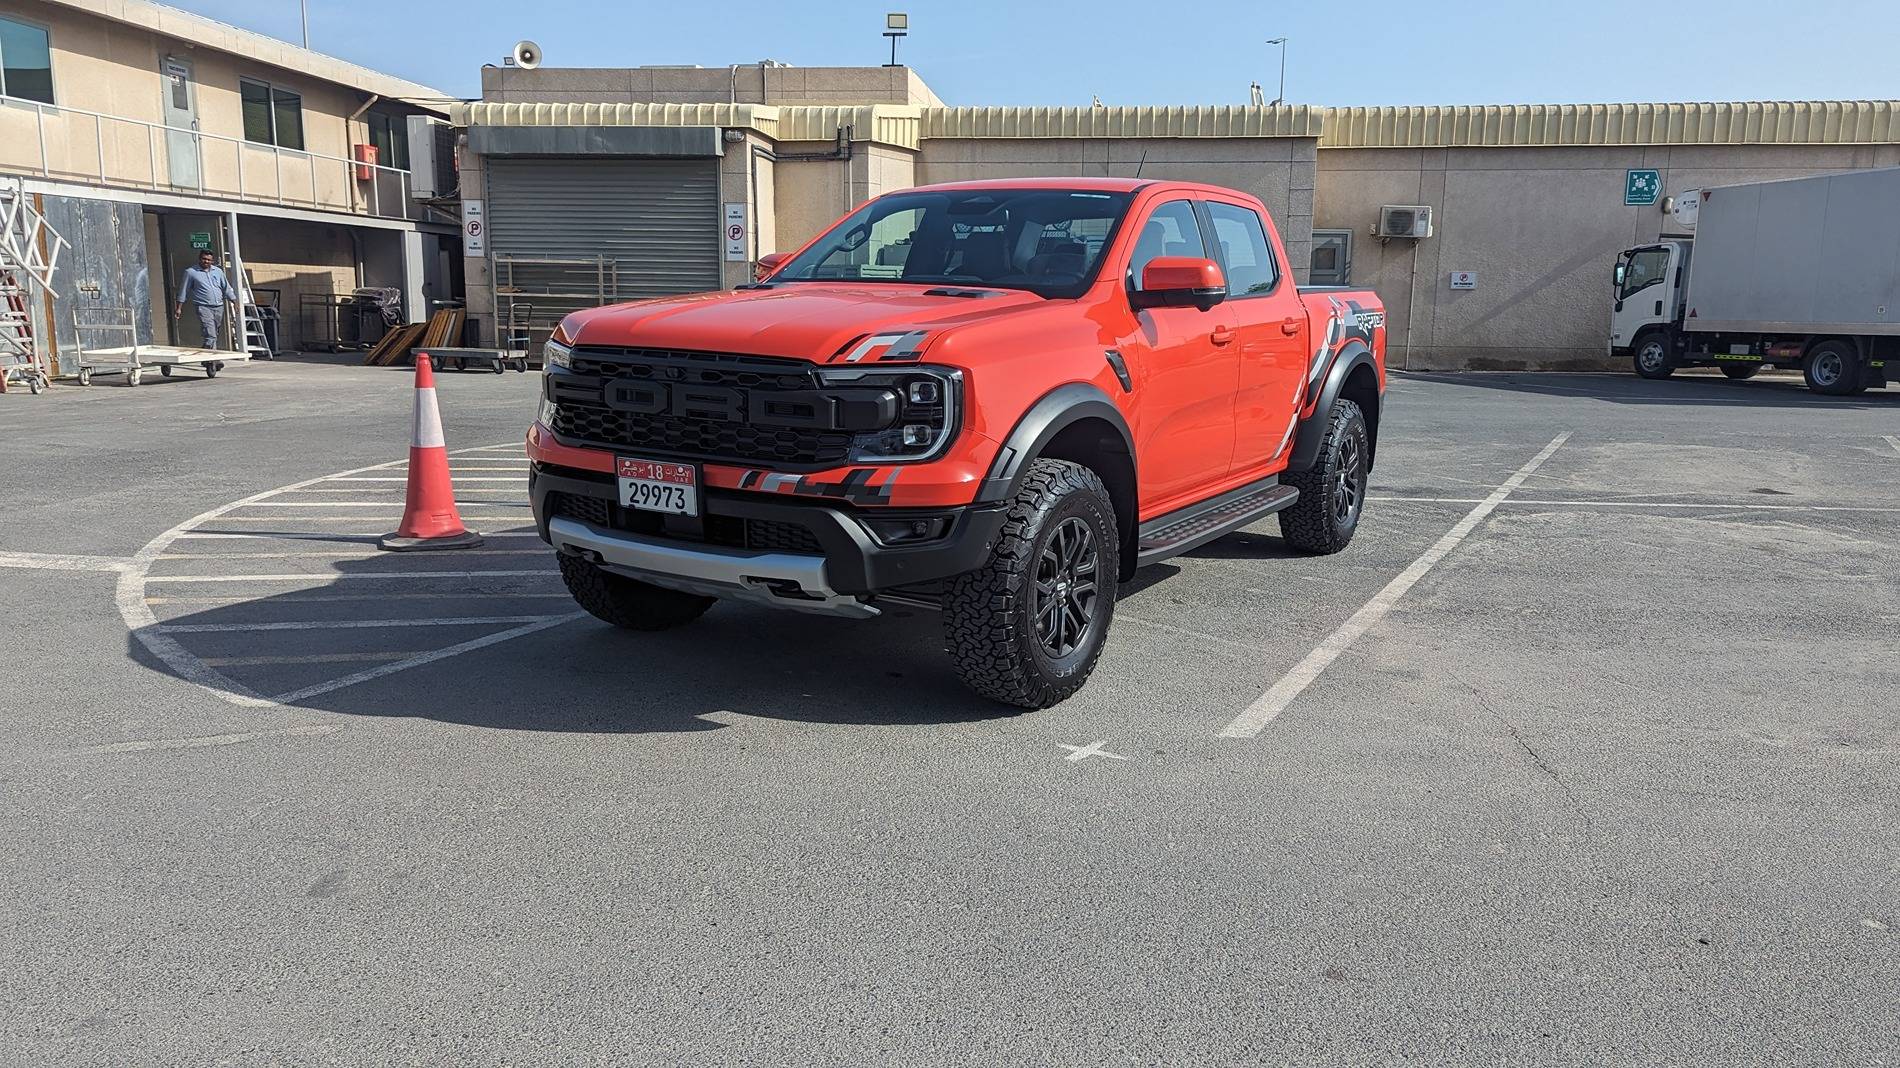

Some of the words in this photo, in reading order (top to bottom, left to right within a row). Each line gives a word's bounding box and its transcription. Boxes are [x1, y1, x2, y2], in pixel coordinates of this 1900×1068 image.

[545, 371, 836, 430] FORD
[647, 464, 663, 480] 18
[629, 482, 685, 509] 29973
